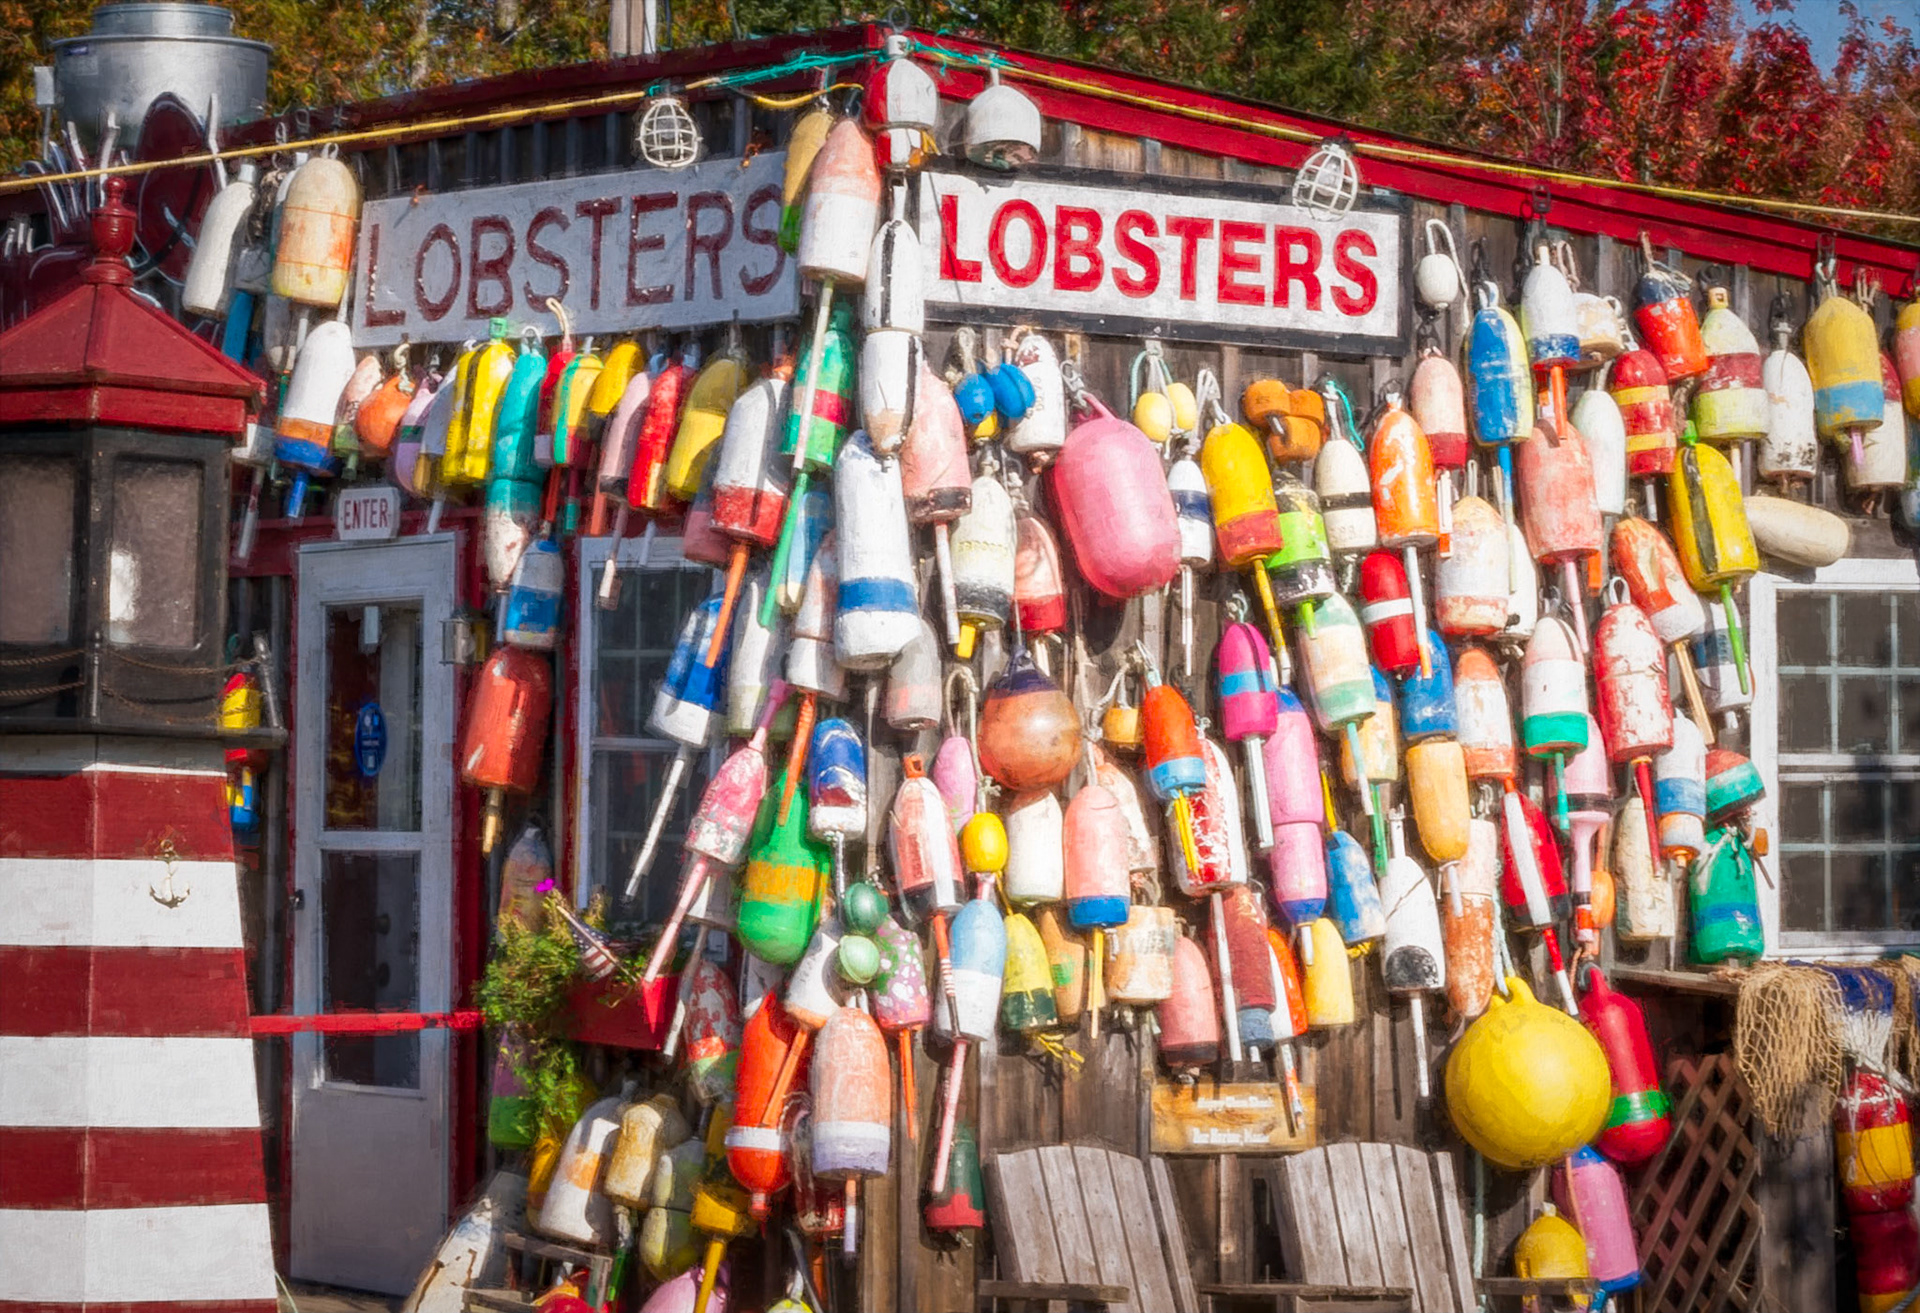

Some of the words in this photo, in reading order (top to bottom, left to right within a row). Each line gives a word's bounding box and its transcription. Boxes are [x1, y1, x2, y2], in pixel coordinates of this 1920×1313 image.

[364, 183, 785, 328] LOBSTERS
[939, 194, 1379, 317] LOBSTERS
[344, 498, 388, 530] ENTER
